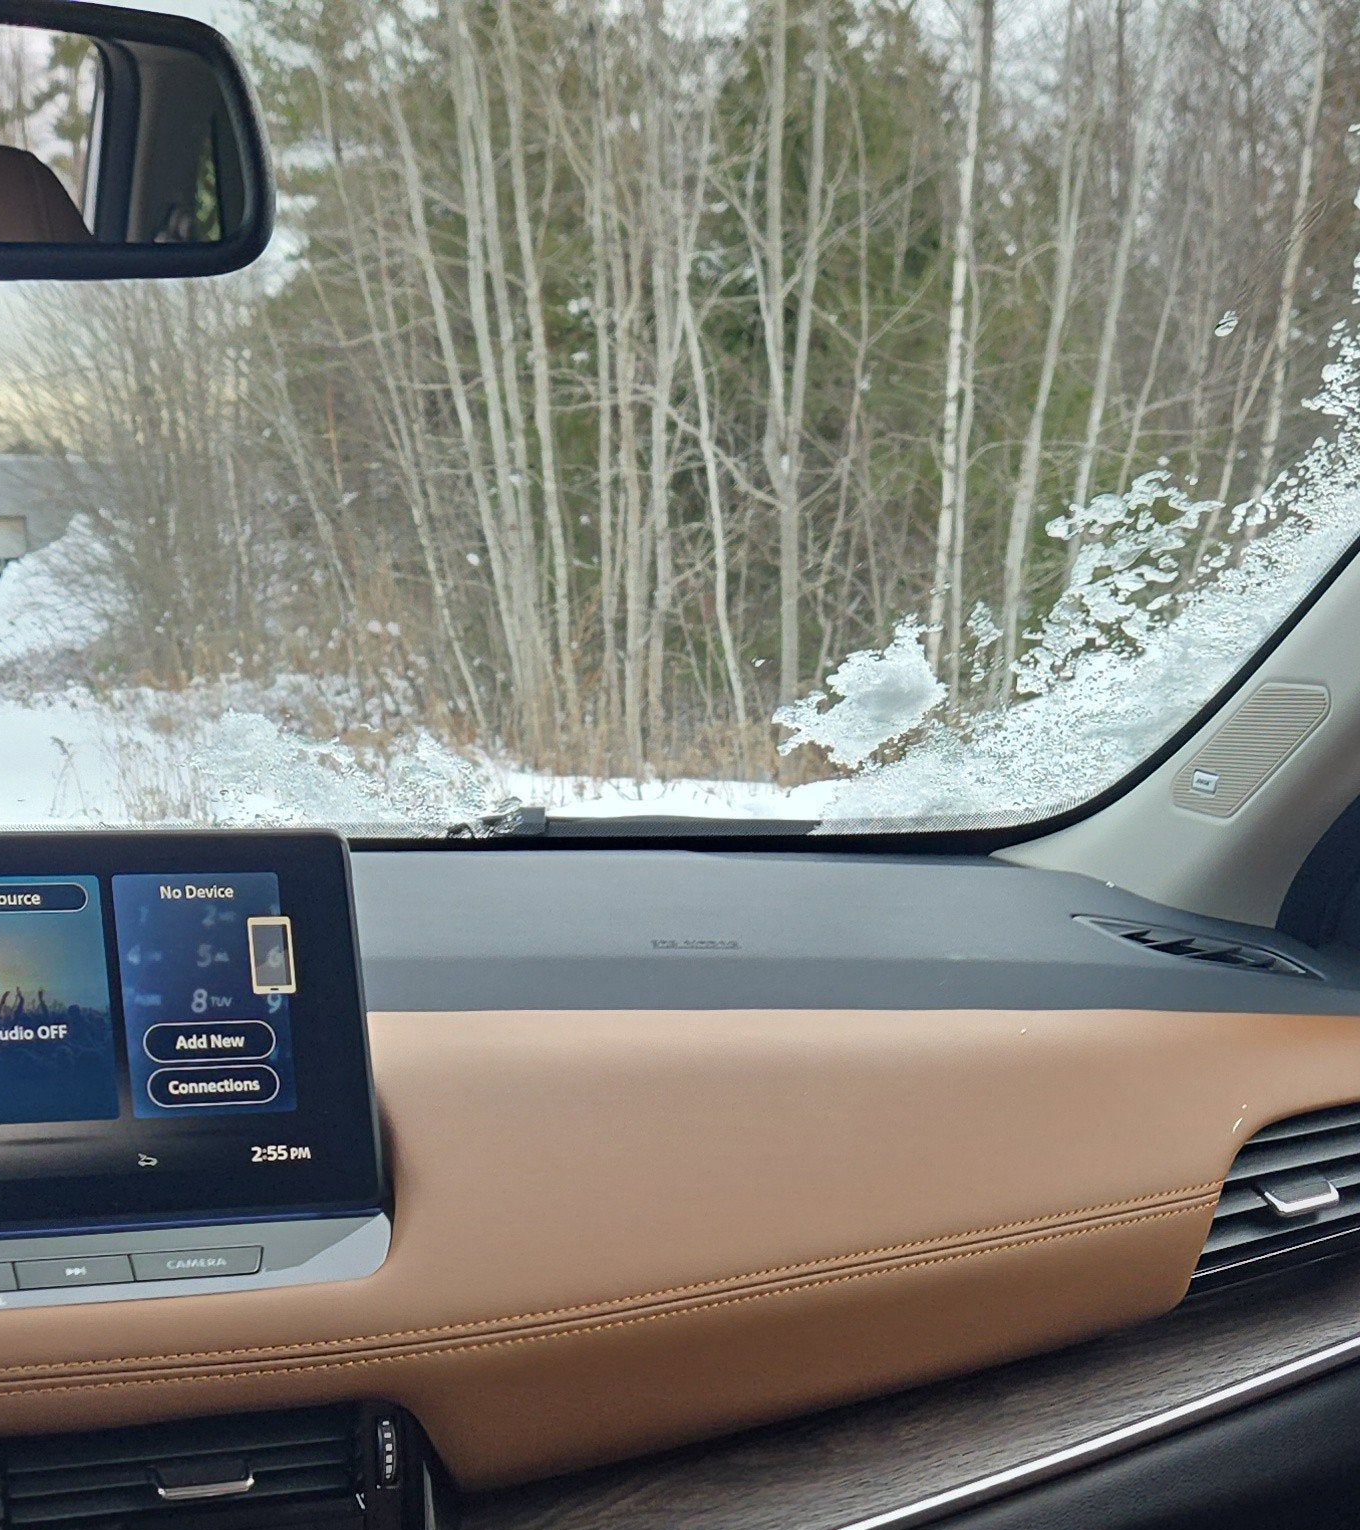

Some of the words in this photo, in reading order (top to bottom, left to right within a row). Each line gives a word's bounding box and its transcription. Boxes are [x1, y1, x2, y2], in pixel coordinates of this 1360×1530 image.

[160, 885, 182, 899] No
[185, 884, 234, 899] Device
[191, 988, 208, 1014] 8
[37, 1025, 68, 1041] OFF
[175, 1033, 207, 1050] Add
[210, 1033, 246, 1049] New
[168, 1077, 261, 1095] Connections
[250, 1145, 289, 1162] 2:55
[290, 1146, 312, 1159] PM
[166, 1257, 228, 1270] CAMERA
